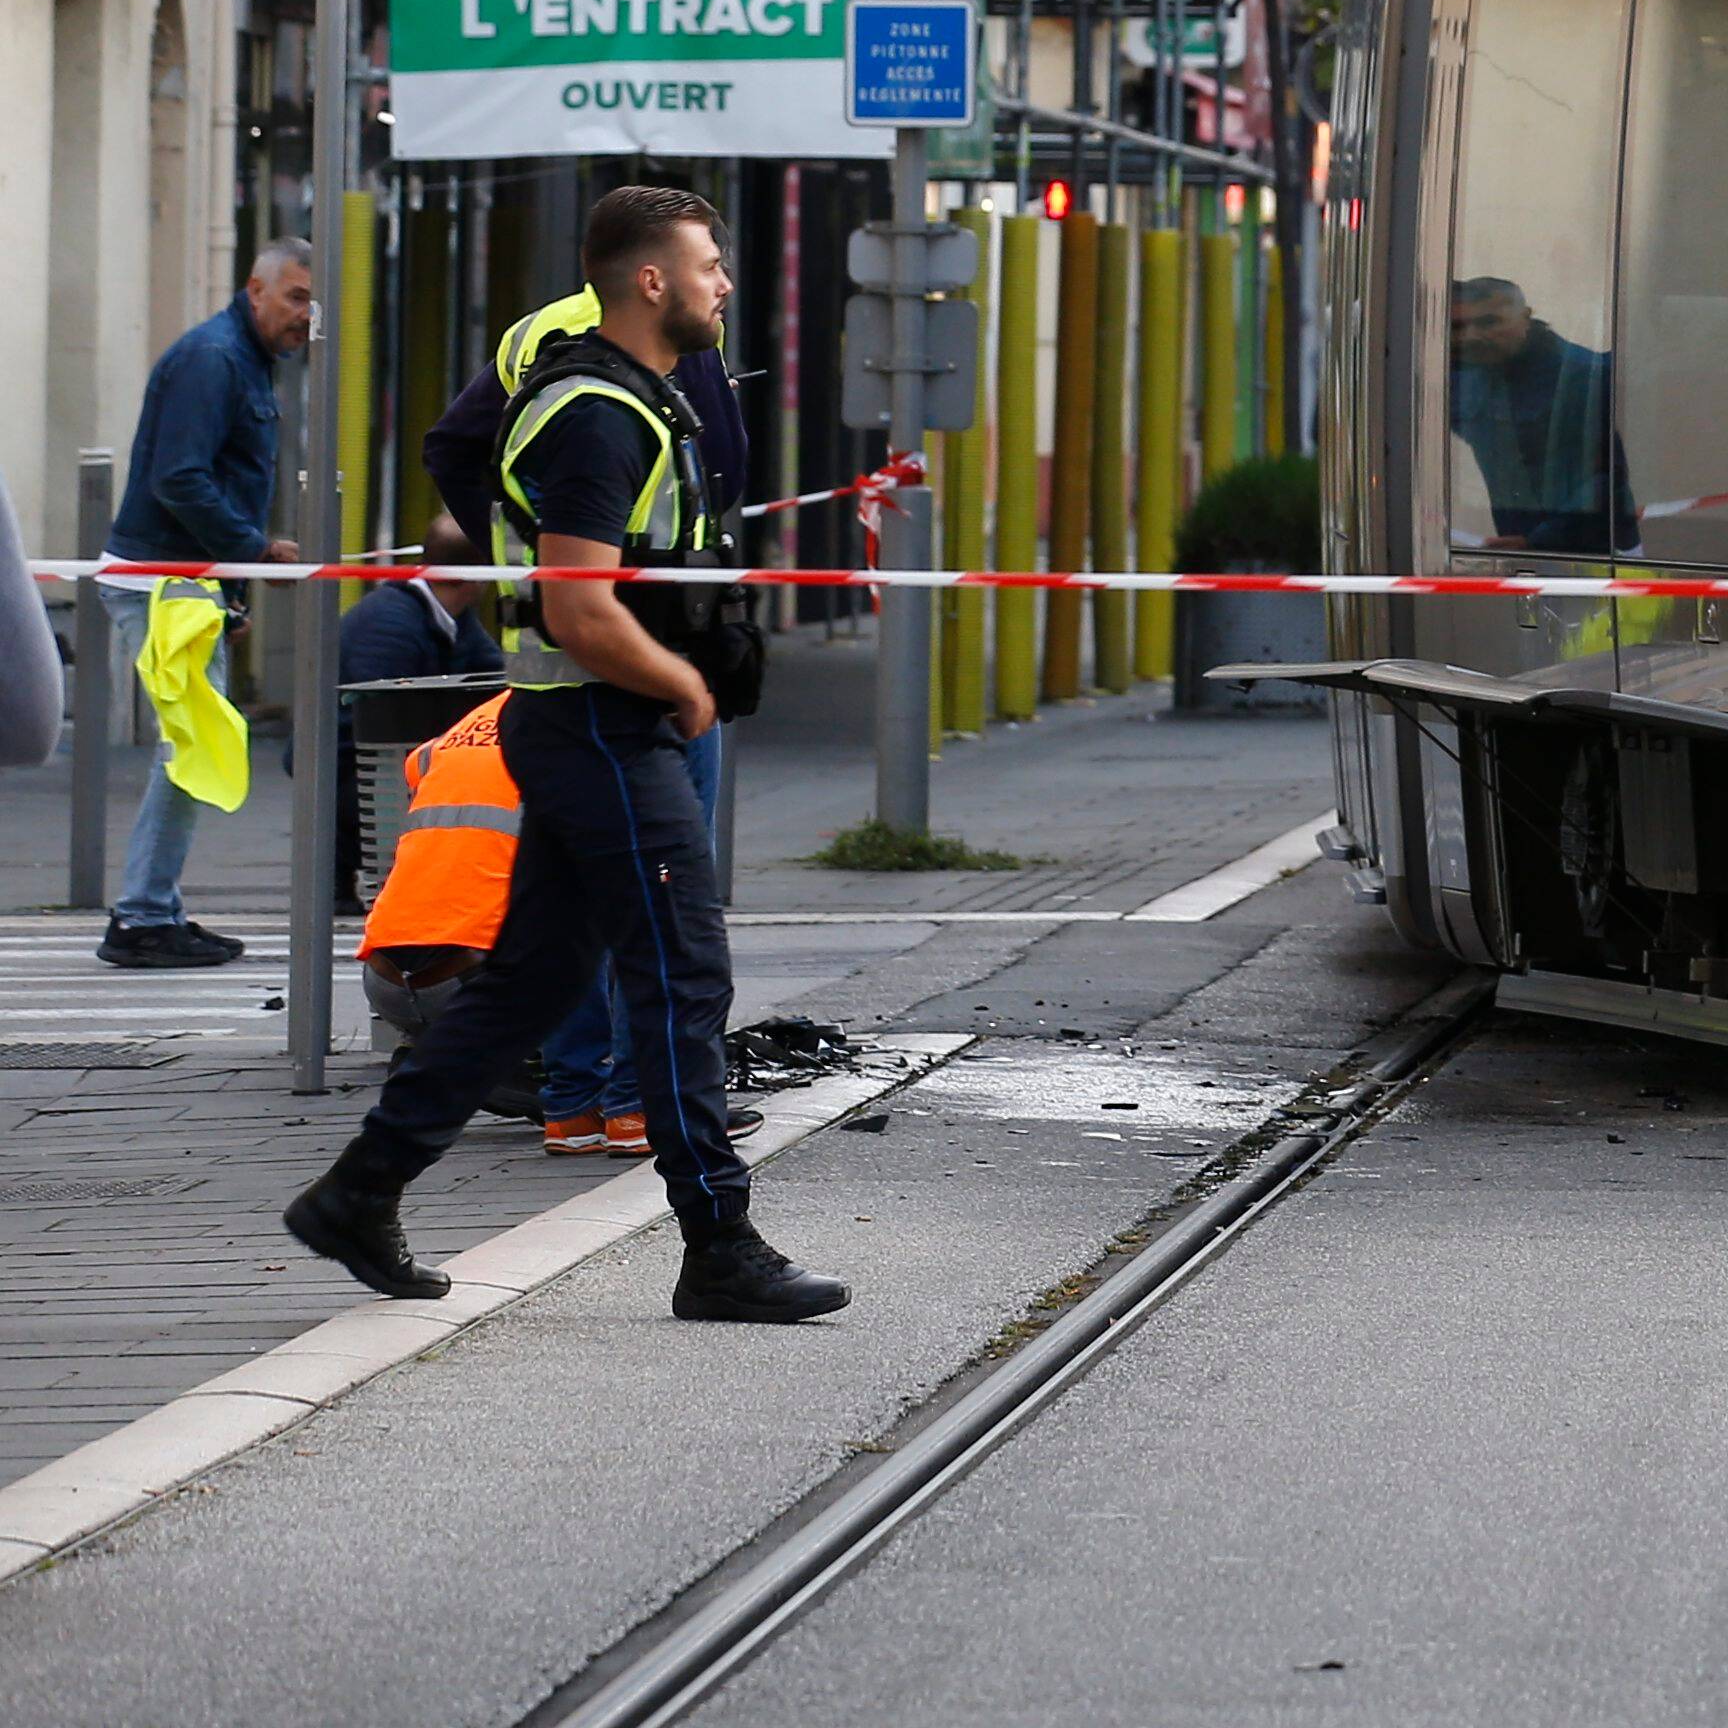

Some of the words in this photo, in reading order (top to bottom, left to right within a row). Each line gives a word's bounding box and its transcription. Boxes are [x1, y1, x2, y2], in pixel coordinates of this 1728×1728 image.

[889, 22, 932, 38] ZONE
[870, 43, 950, 59] PIÉTONNE
[561, 80, 734, 112] OUVERT
